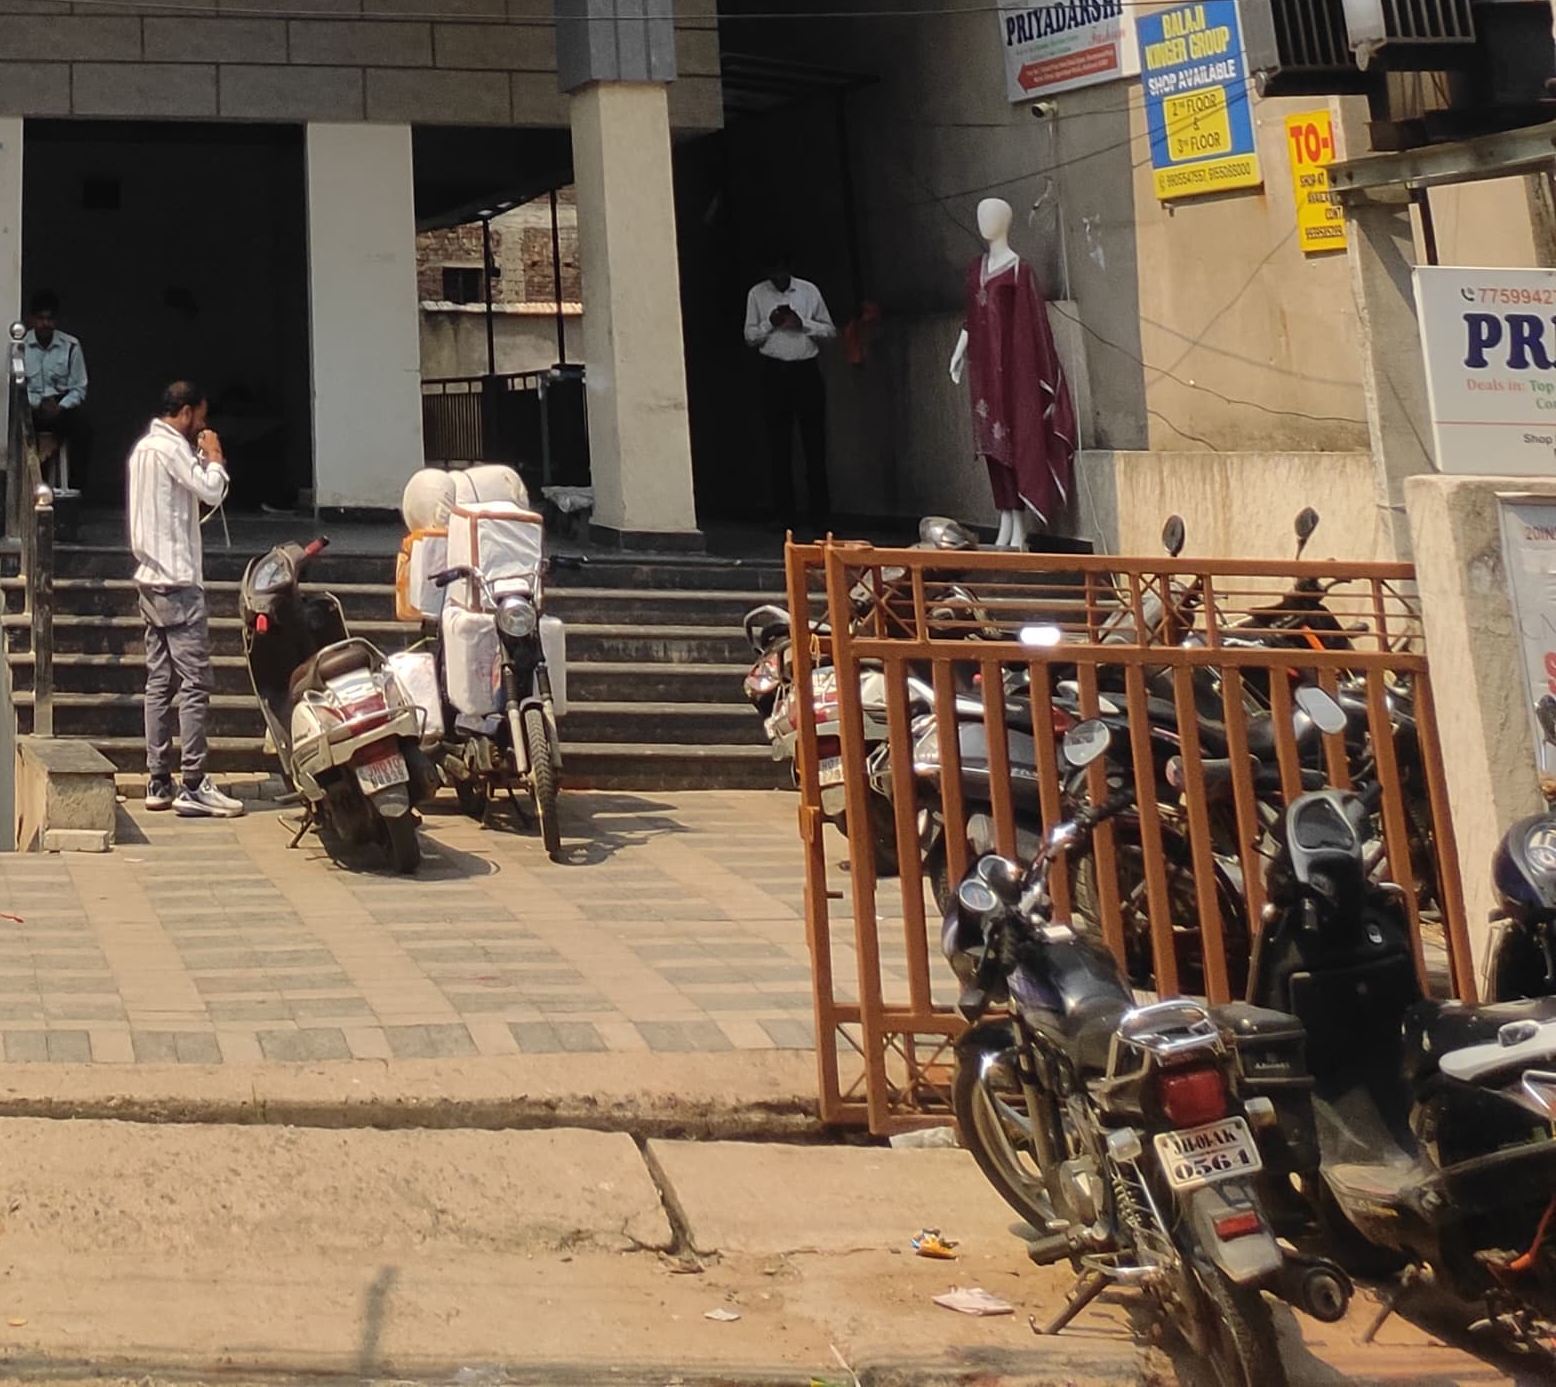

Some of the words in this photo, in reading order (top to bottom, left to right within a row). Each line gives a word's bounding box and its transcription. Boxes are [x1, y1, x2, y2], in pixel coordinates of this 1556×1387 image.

[1162, 5, 1206, 39] BALAJI
[1189, 26, 1230, 61] GROUP
[1148, 73, 1177, 96] SHOP
[1178, 59, 1237, 90] AVAILABLE
[1186, 93, 1218, 115] FLOOR
[1190, 132, 1221, 152] FLOOR
[1463, 313, 1556, 371] PR
[1467, 379, 1504, 392] Deals
[1508, 379, 1525, 392] in:
[1529, 380, 1555, 395] Top
[1523, 433, 1554, 446] Shop
